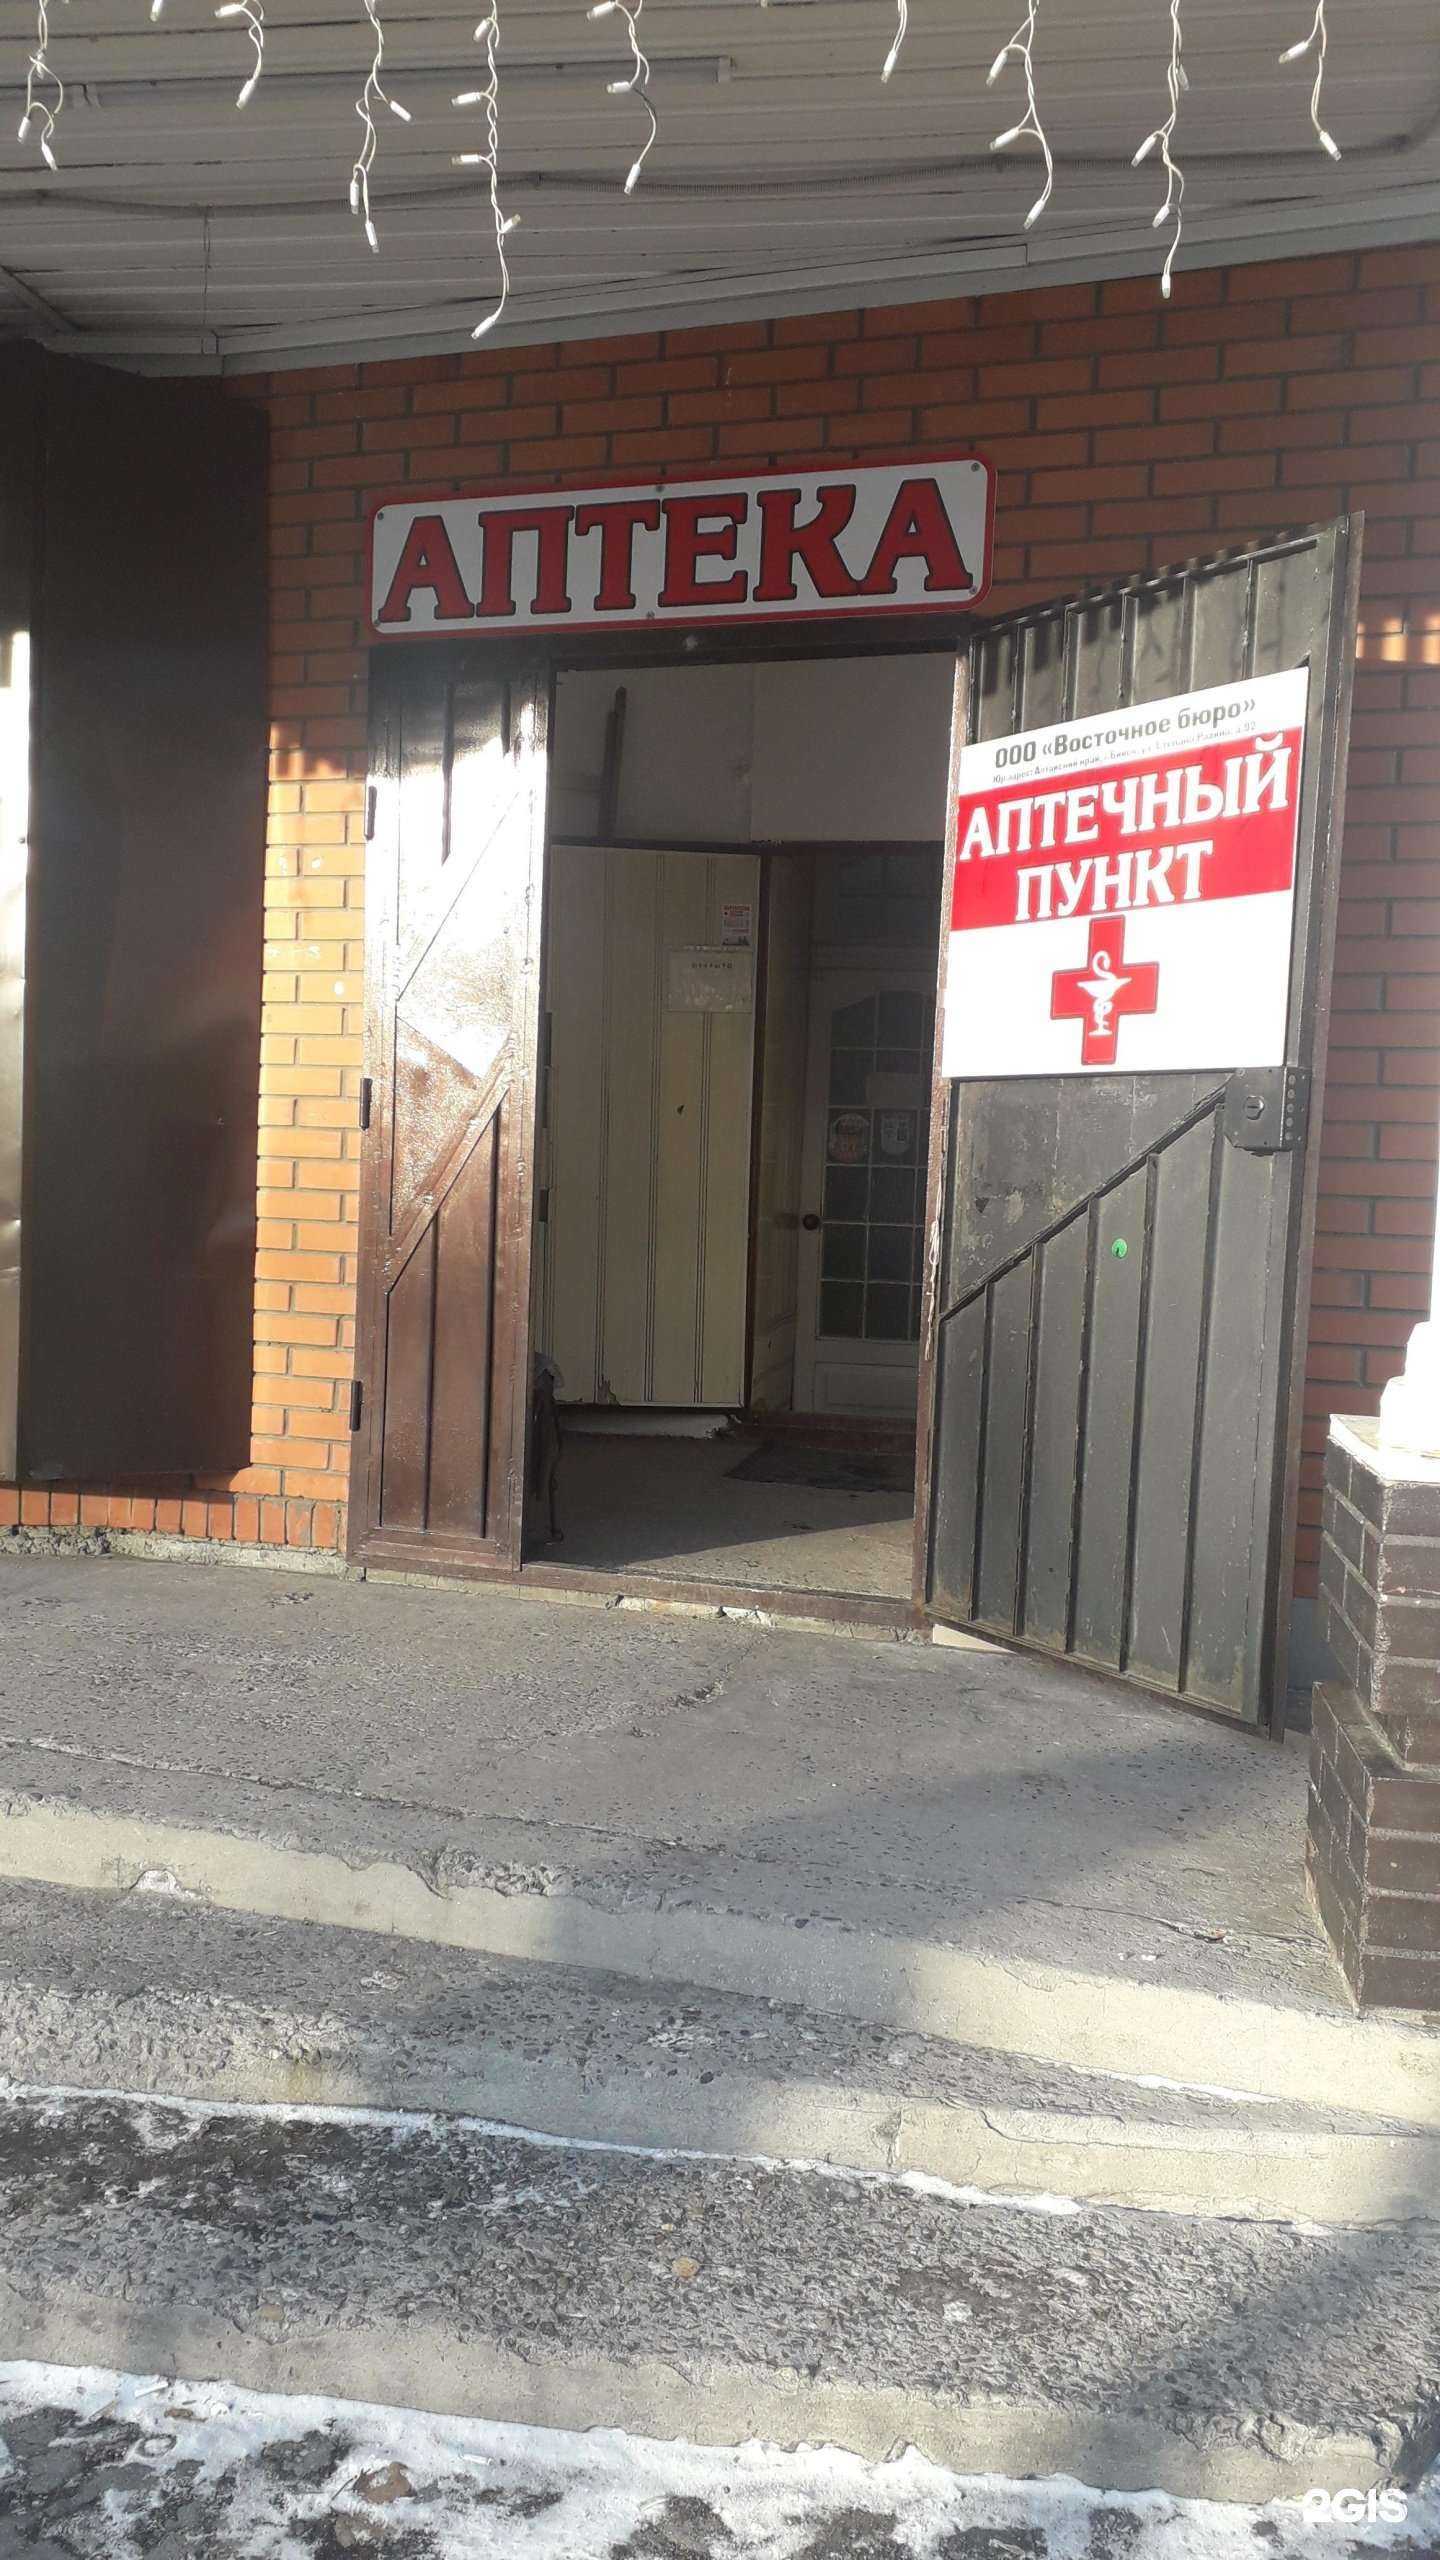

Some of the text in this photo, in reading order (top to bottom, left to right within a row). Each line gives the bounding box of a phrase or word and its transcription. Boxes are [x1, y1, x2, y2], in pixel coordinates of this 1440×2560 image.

[378, 477, 975, 622] АПТЕКА
[995, 698, 1256, 768] ООО «Восточное бюро»
[959, 732, 1292, 861] АПТЕЧНЫЙ
[1015, 839, 1214, 922] ПУНКТ
